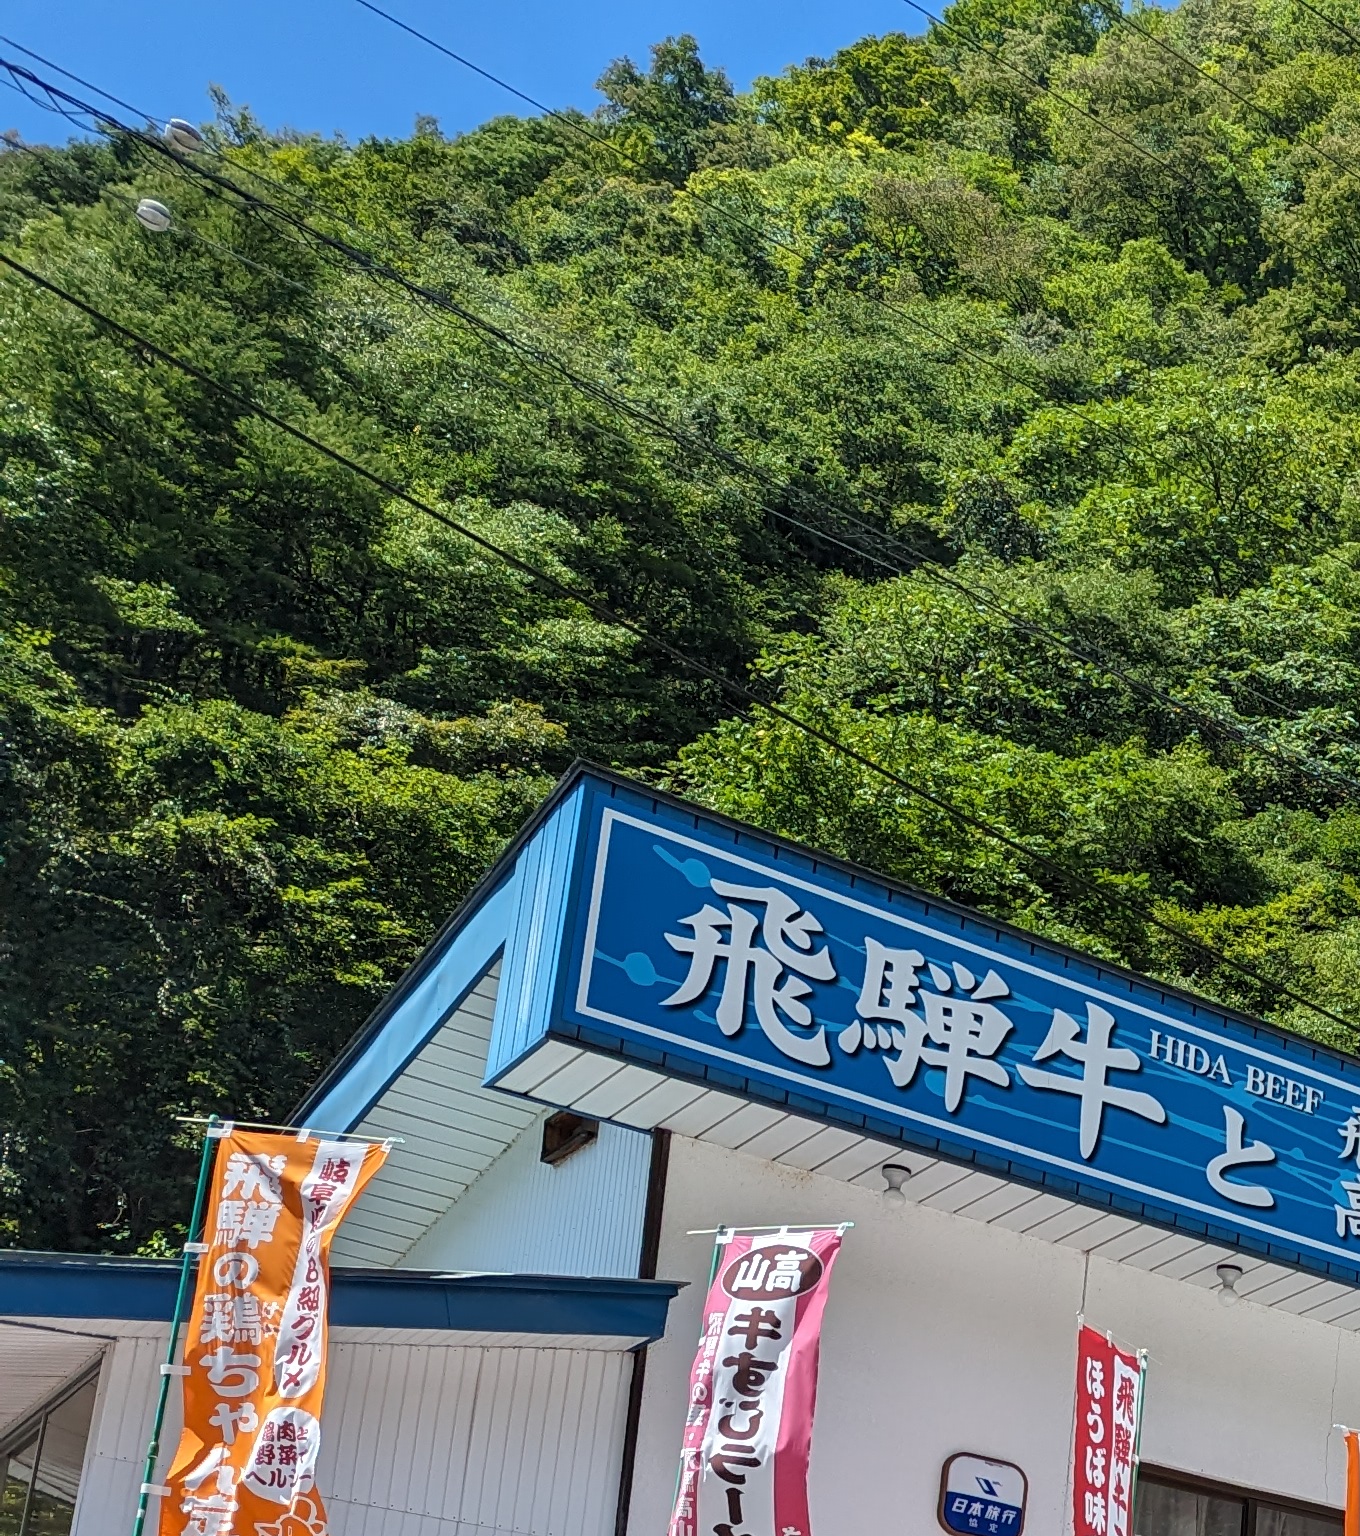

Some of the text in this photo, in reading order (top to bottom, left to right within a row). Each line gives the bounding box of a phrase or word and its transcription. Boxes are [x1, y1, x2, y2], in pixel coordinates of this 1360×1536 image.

[660, 878, 1166, 1159] 飛騨牛
[1148, 1029, 1325, 1114] HIDA BEEF
[1206, 1104, 1276, 1208] と
[951, 1497, 1017, 1525] 日本旅行
